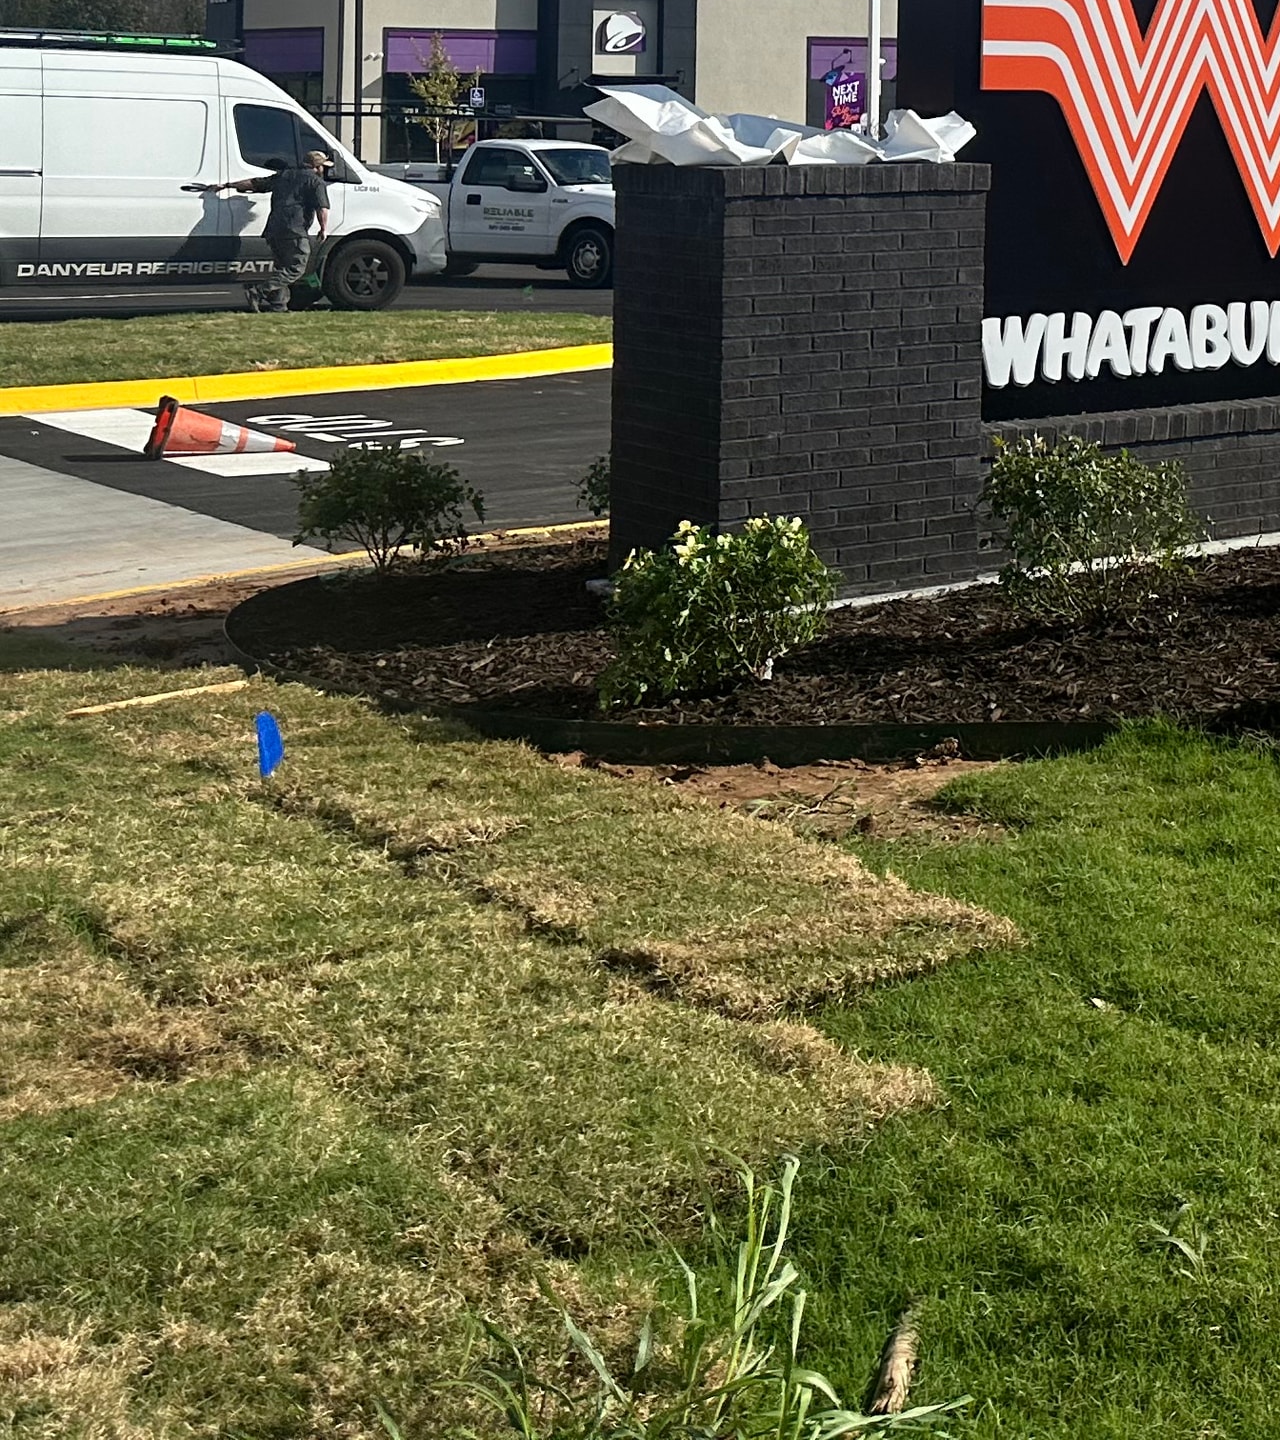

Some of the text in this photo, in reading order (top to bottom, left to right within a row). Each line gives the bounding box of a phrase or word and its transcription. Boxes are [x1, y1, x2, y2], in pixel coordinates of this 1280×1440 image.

[832, 81, 860, 97] NEXT
[833, 92, 858, 106] TIME
[483, 207, 534, 218] RELIABLE
[17, 260, 276, 278] DANYEUR REFRIGERATI
